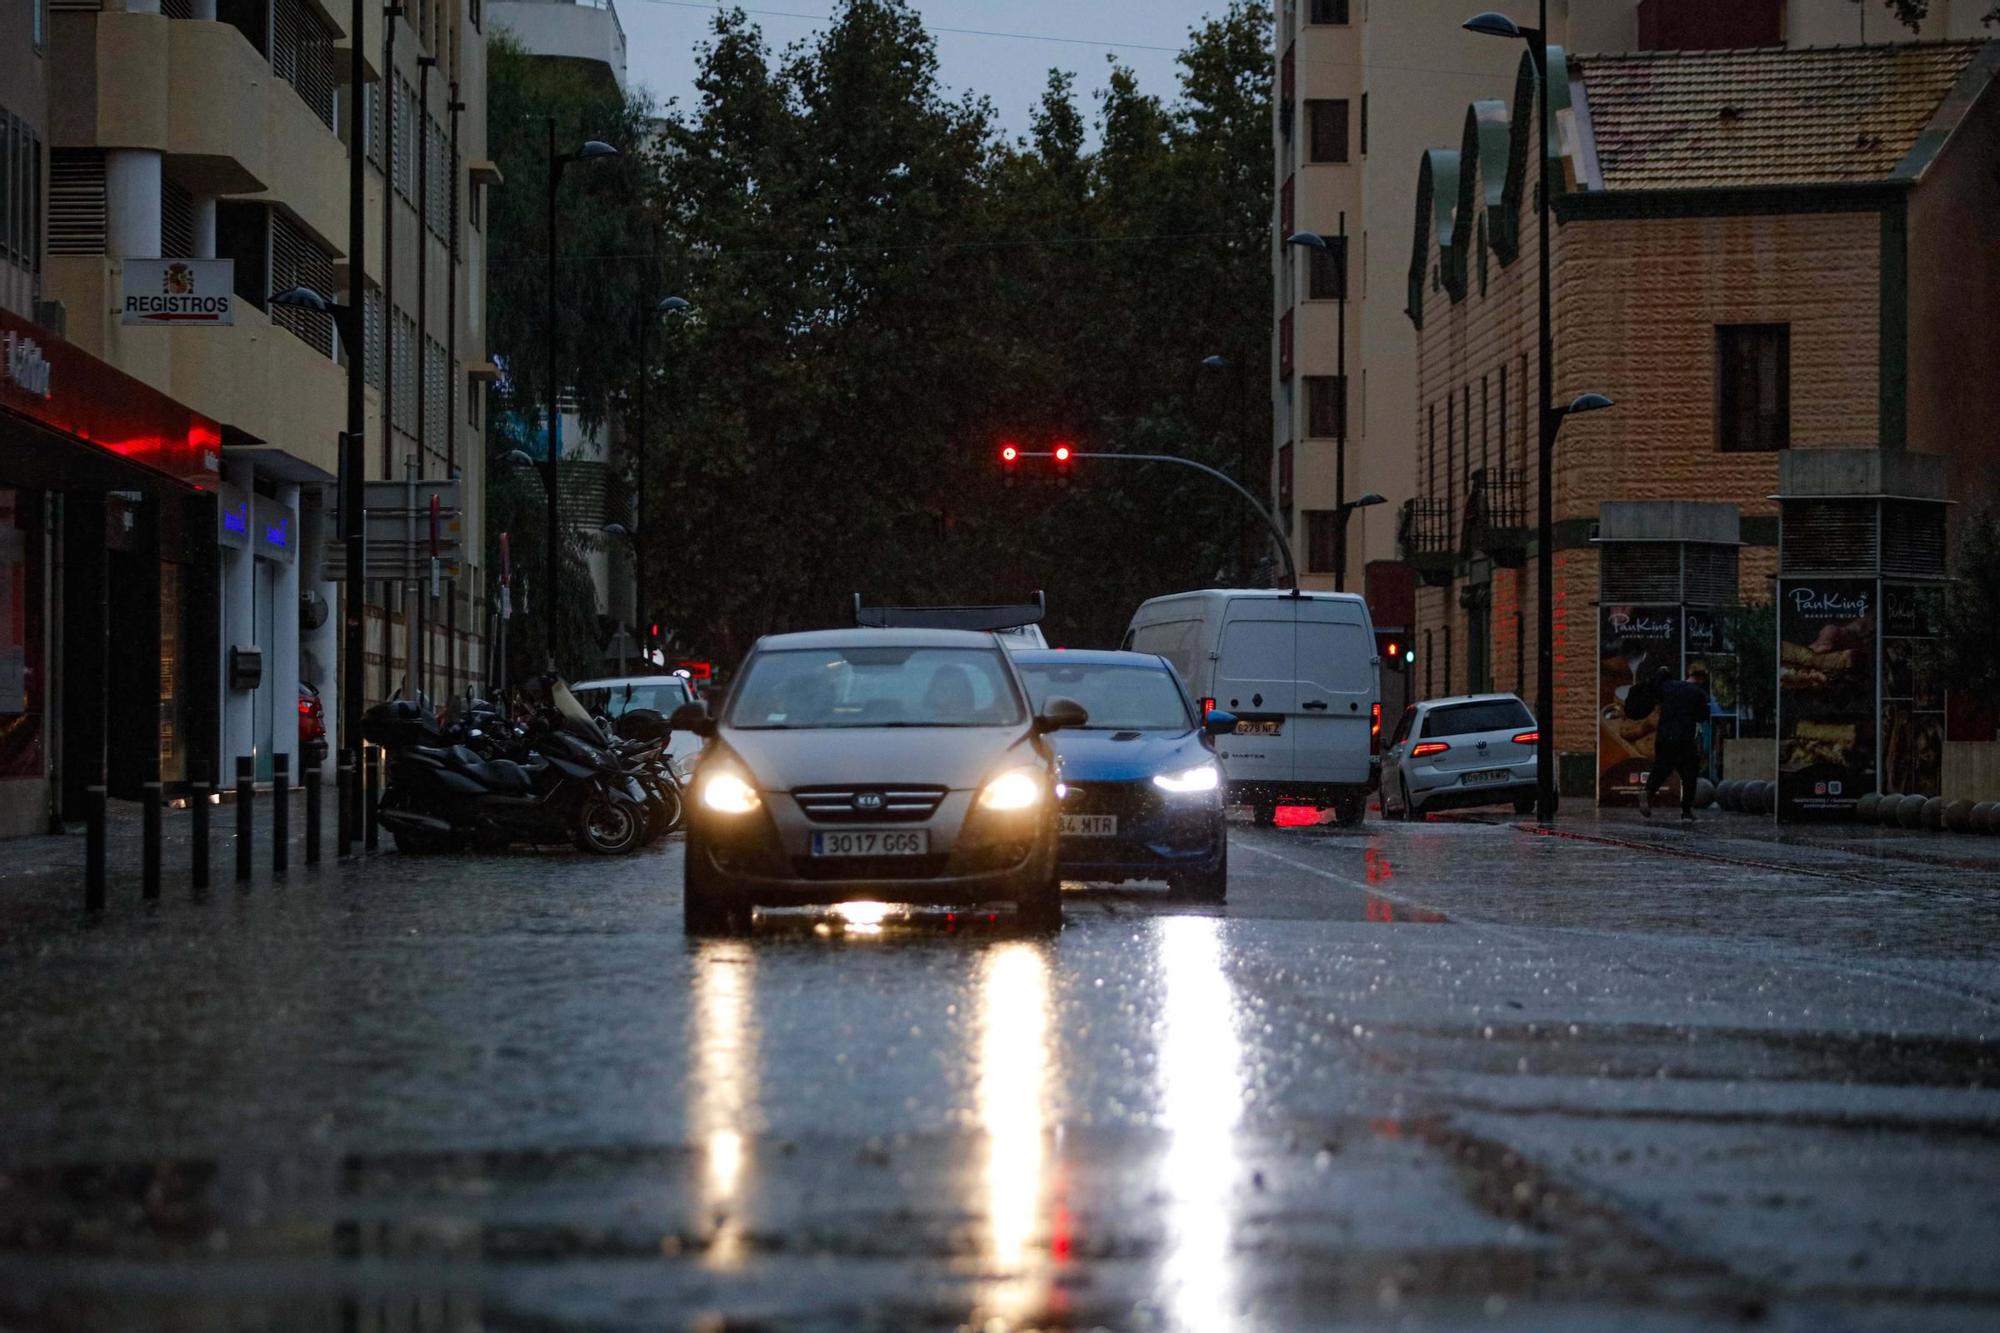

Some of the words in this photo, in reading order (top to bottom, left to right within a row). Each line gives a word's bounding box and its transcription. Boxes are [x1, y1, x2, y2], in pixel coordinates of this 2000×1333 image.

[126, 296, 229, 312] REGISTROS
[1788, 587, 1870, 618] PanKing
[1608, 613, 1673, 640] PanKing
[858, 796, 881, 805] KIA
[1081, 816, 1112, 833] MTR
[829, 834, 876, 853] 3017
[883, 833, 919, 852] GGS
